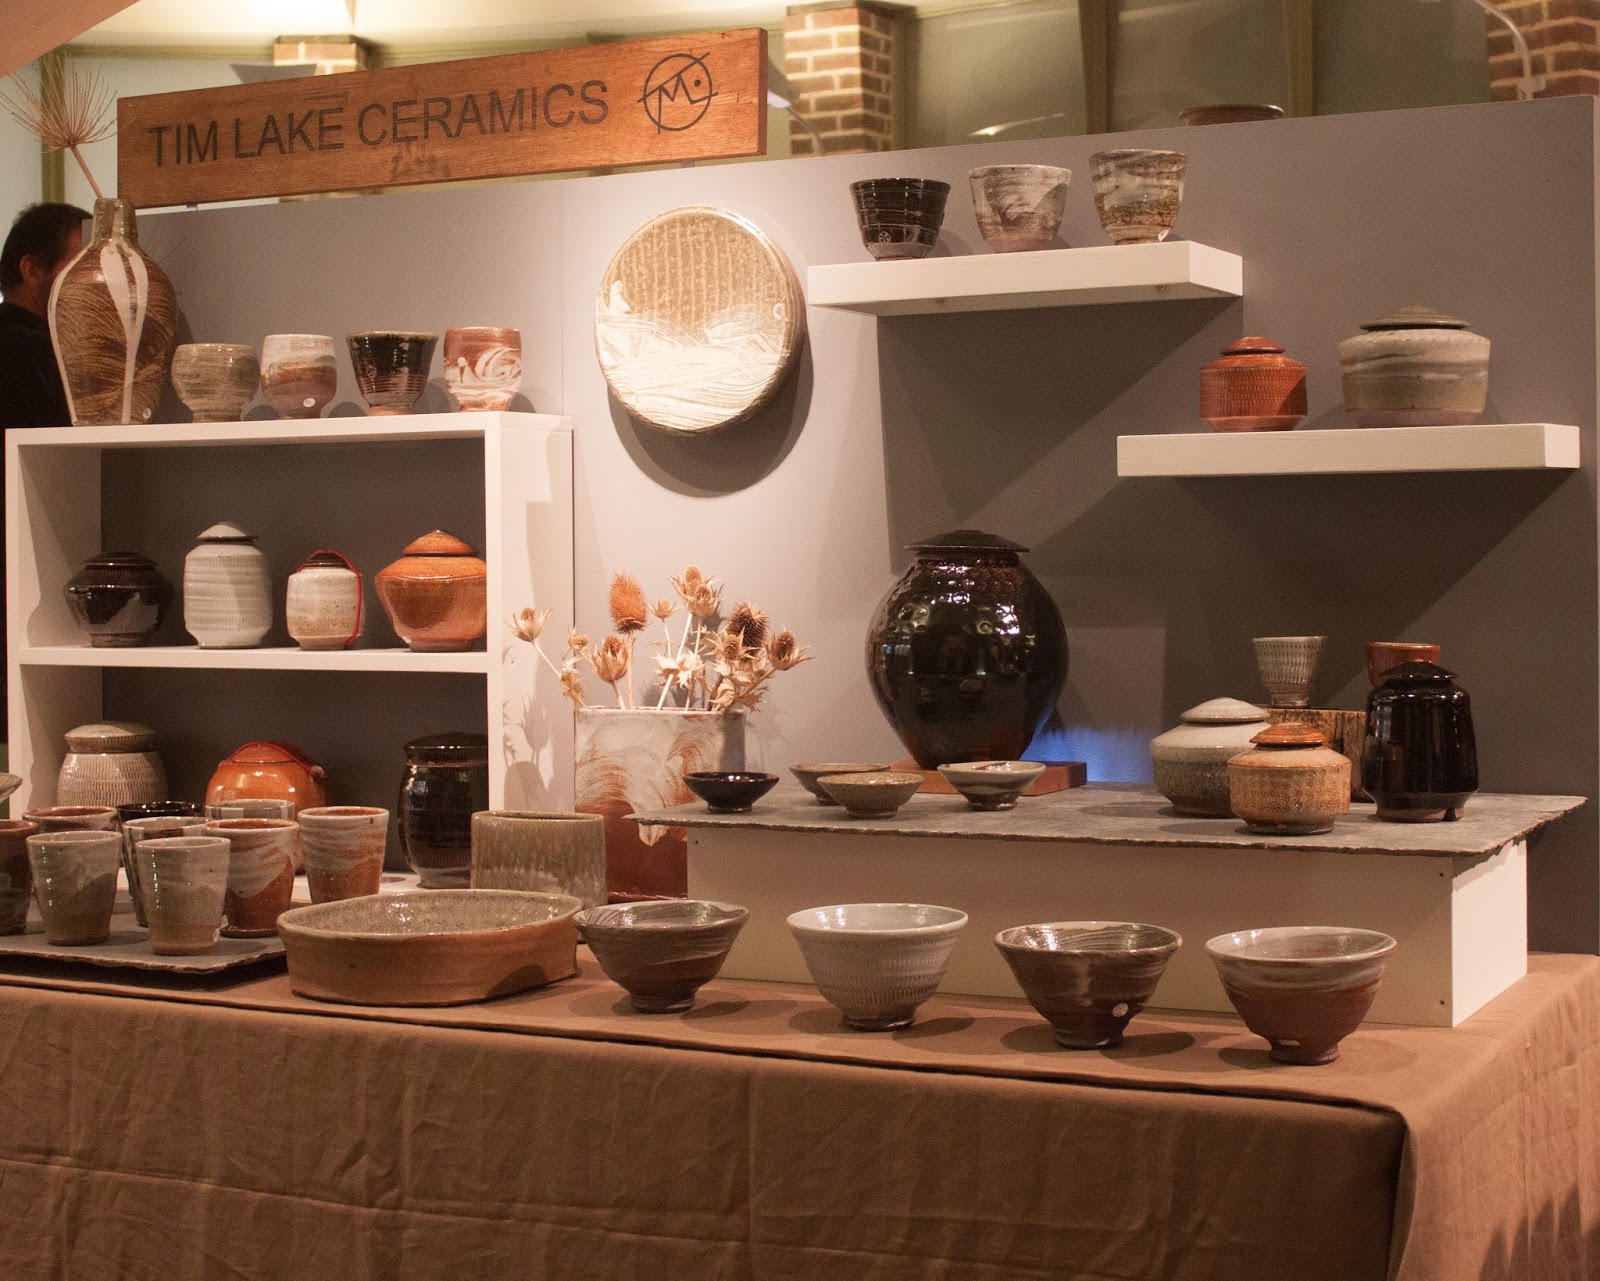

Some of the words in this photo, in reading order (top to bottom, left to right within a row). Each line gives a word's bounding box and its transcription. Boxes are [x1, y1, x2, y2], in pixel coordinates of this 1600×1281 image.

[147, 120, 218, 167] TIM
[234, 106, 345, 159] LAKE
[357, 79, 609, 147] CERAMICS
